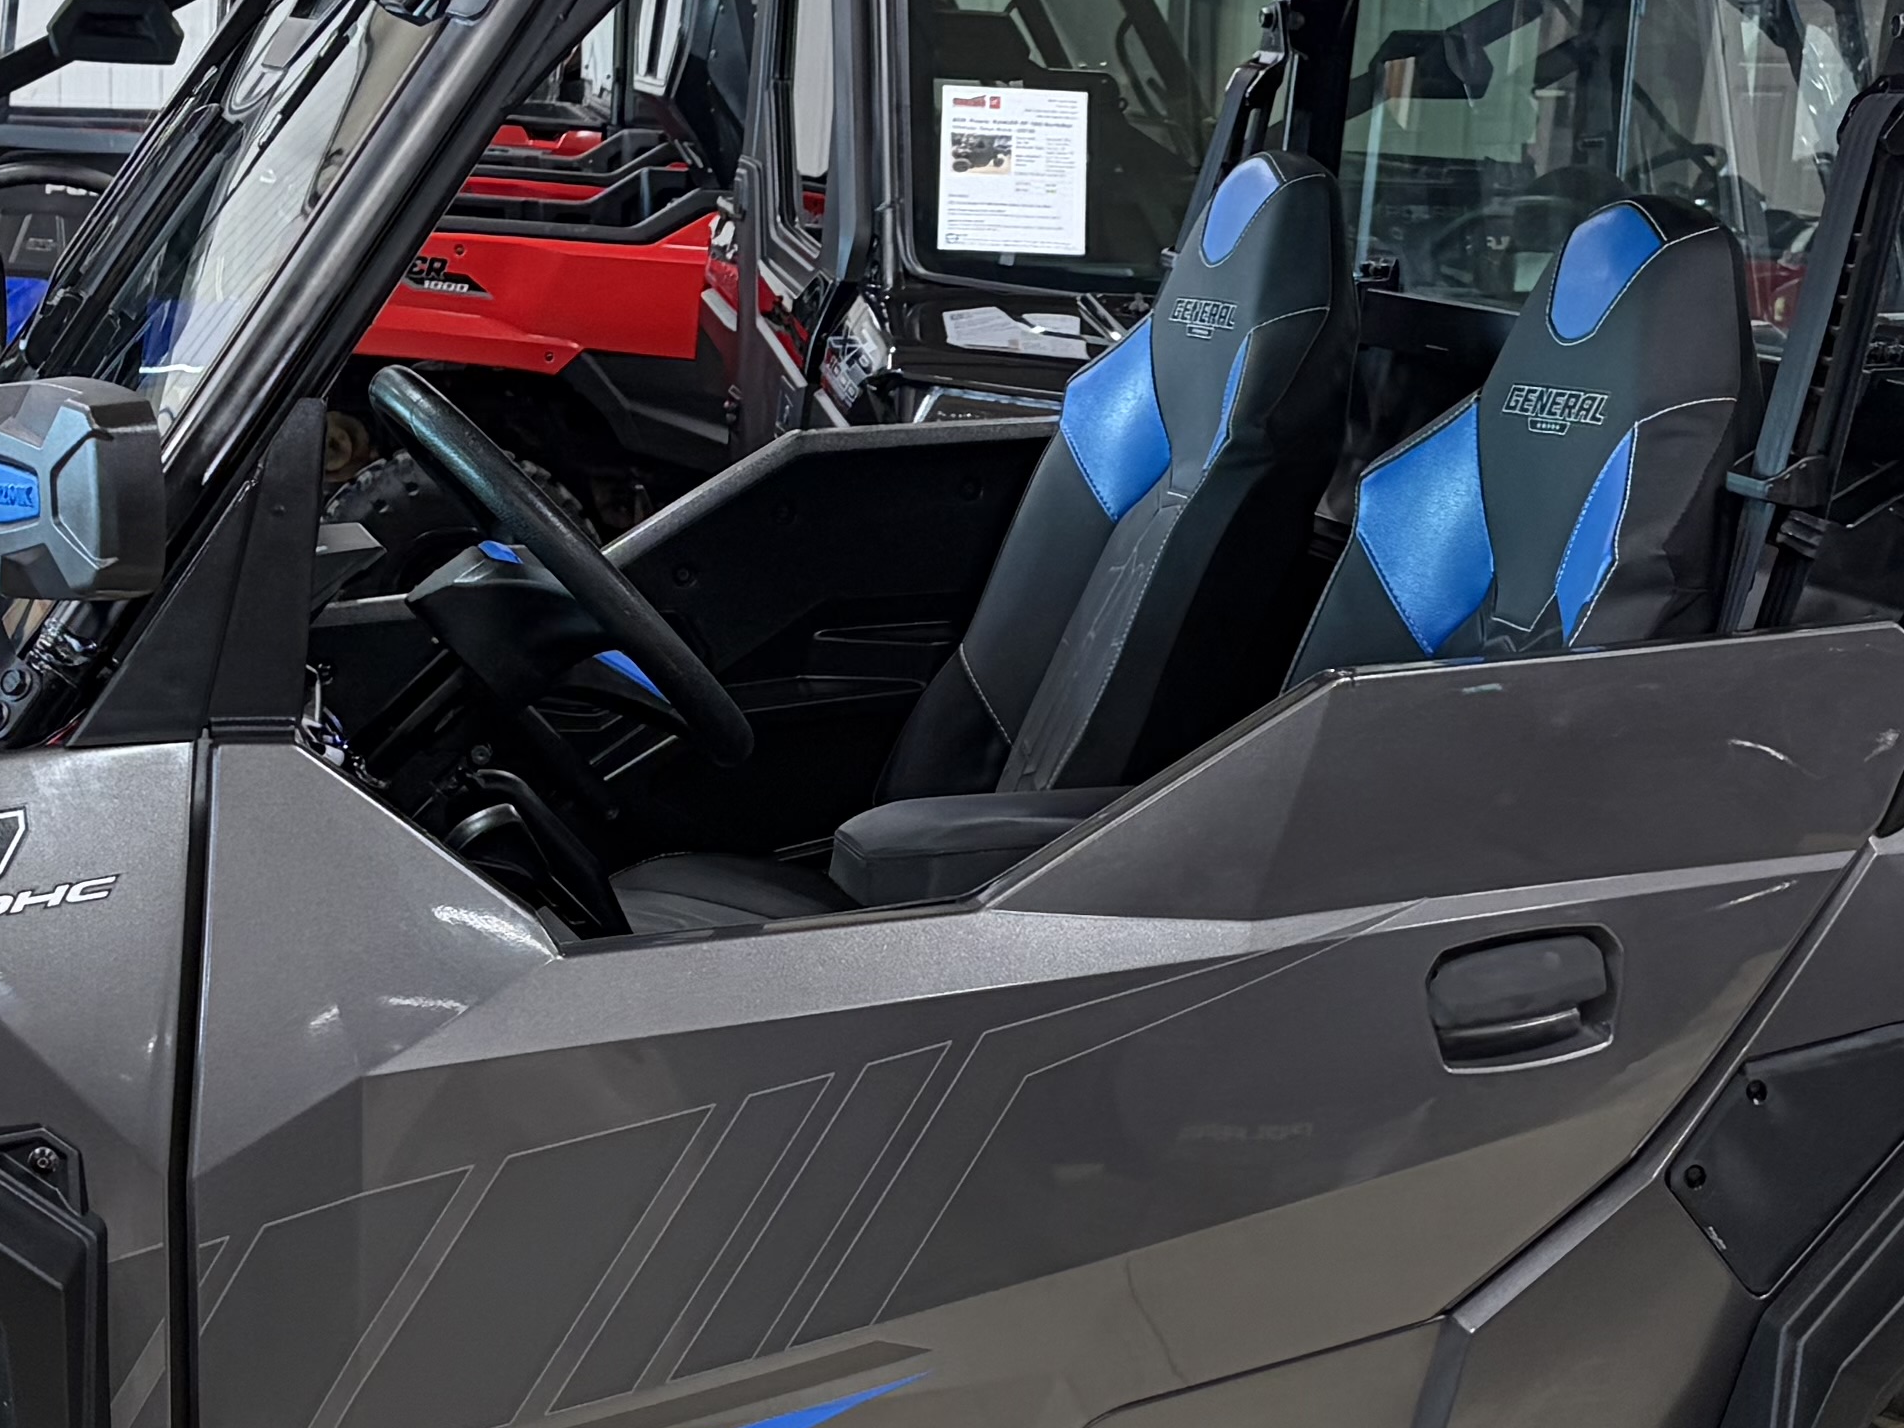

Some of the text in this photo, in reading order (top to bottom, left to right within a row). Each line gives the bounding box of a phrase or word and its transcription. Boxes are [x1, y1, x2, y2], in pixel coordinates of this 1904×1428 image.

[422, 279, 470, 293] 1000
[1168, 297, 1238, 330] GENERAL
[1501, 384, 1609, 426] GENERAL
